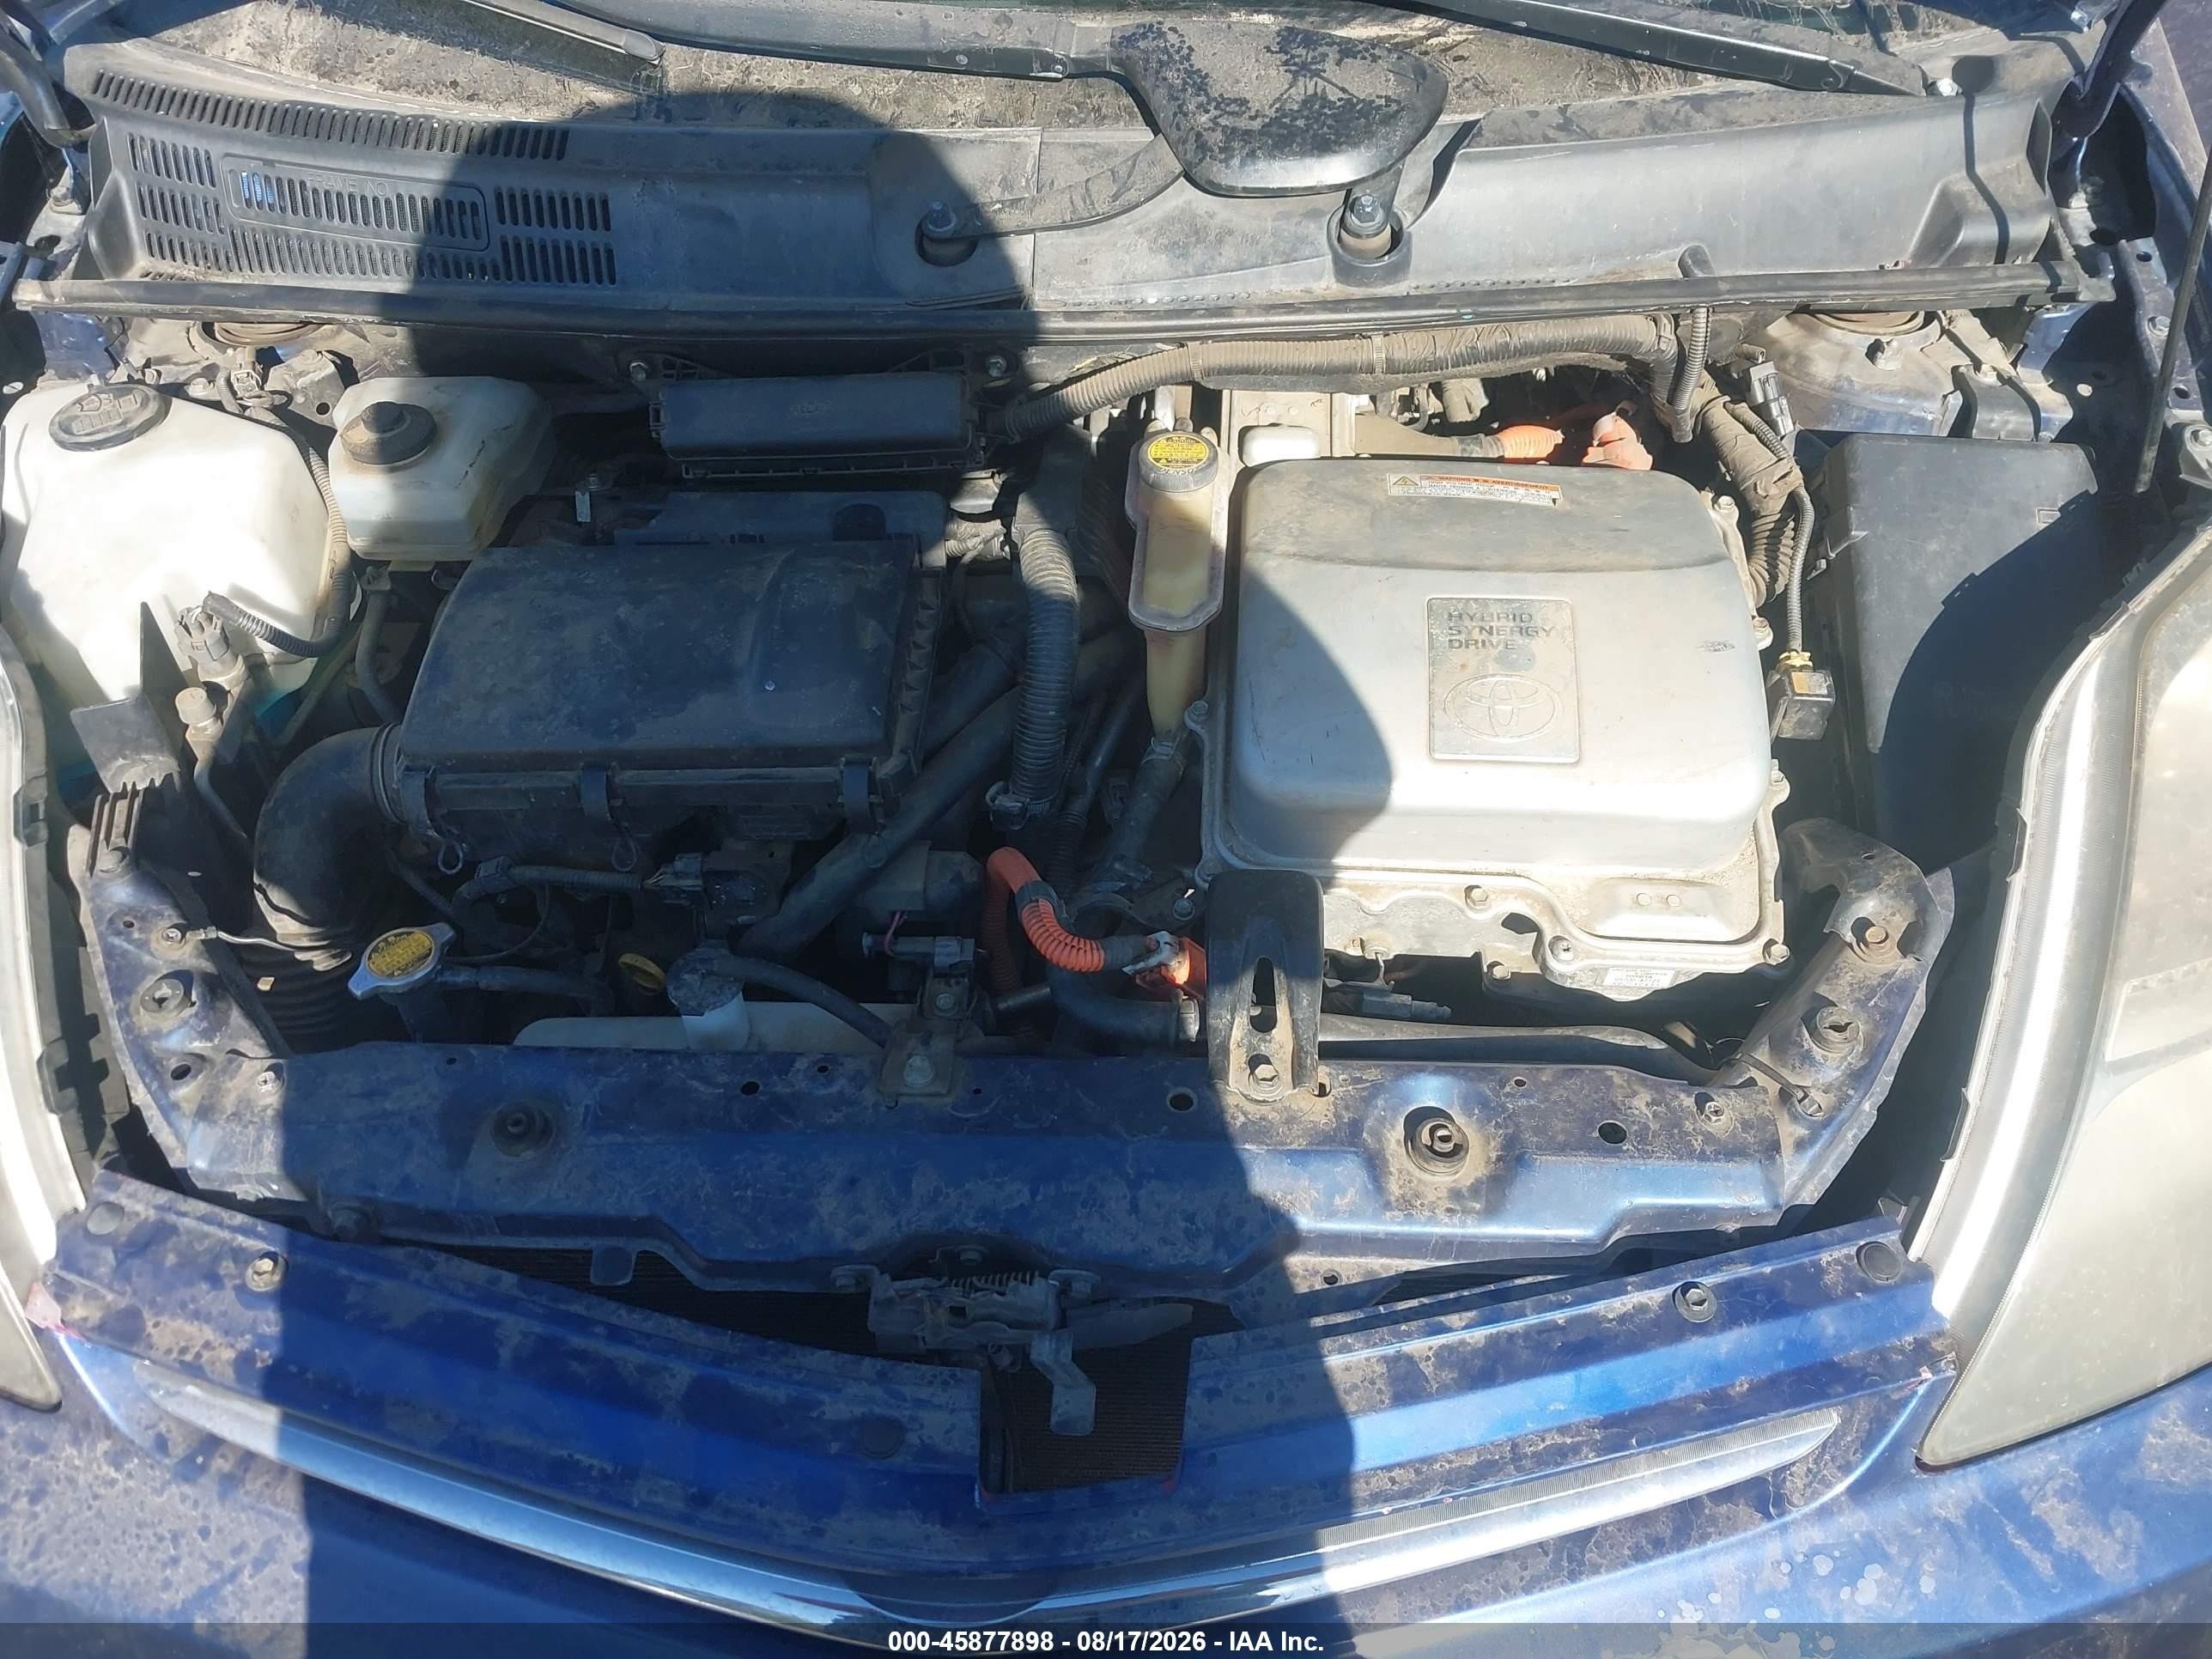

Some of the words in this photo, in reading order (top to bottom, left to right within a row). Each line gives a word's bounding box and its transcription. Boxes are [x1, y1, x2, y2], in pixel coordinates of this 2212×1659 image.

[307, 172, 358, 193] FRAME
[1448, 611, 1533, 623] HYBRID
[1448, 625, 1556, 637] SYNERGY
[1448, 639, 1518, 650] DRIVE
